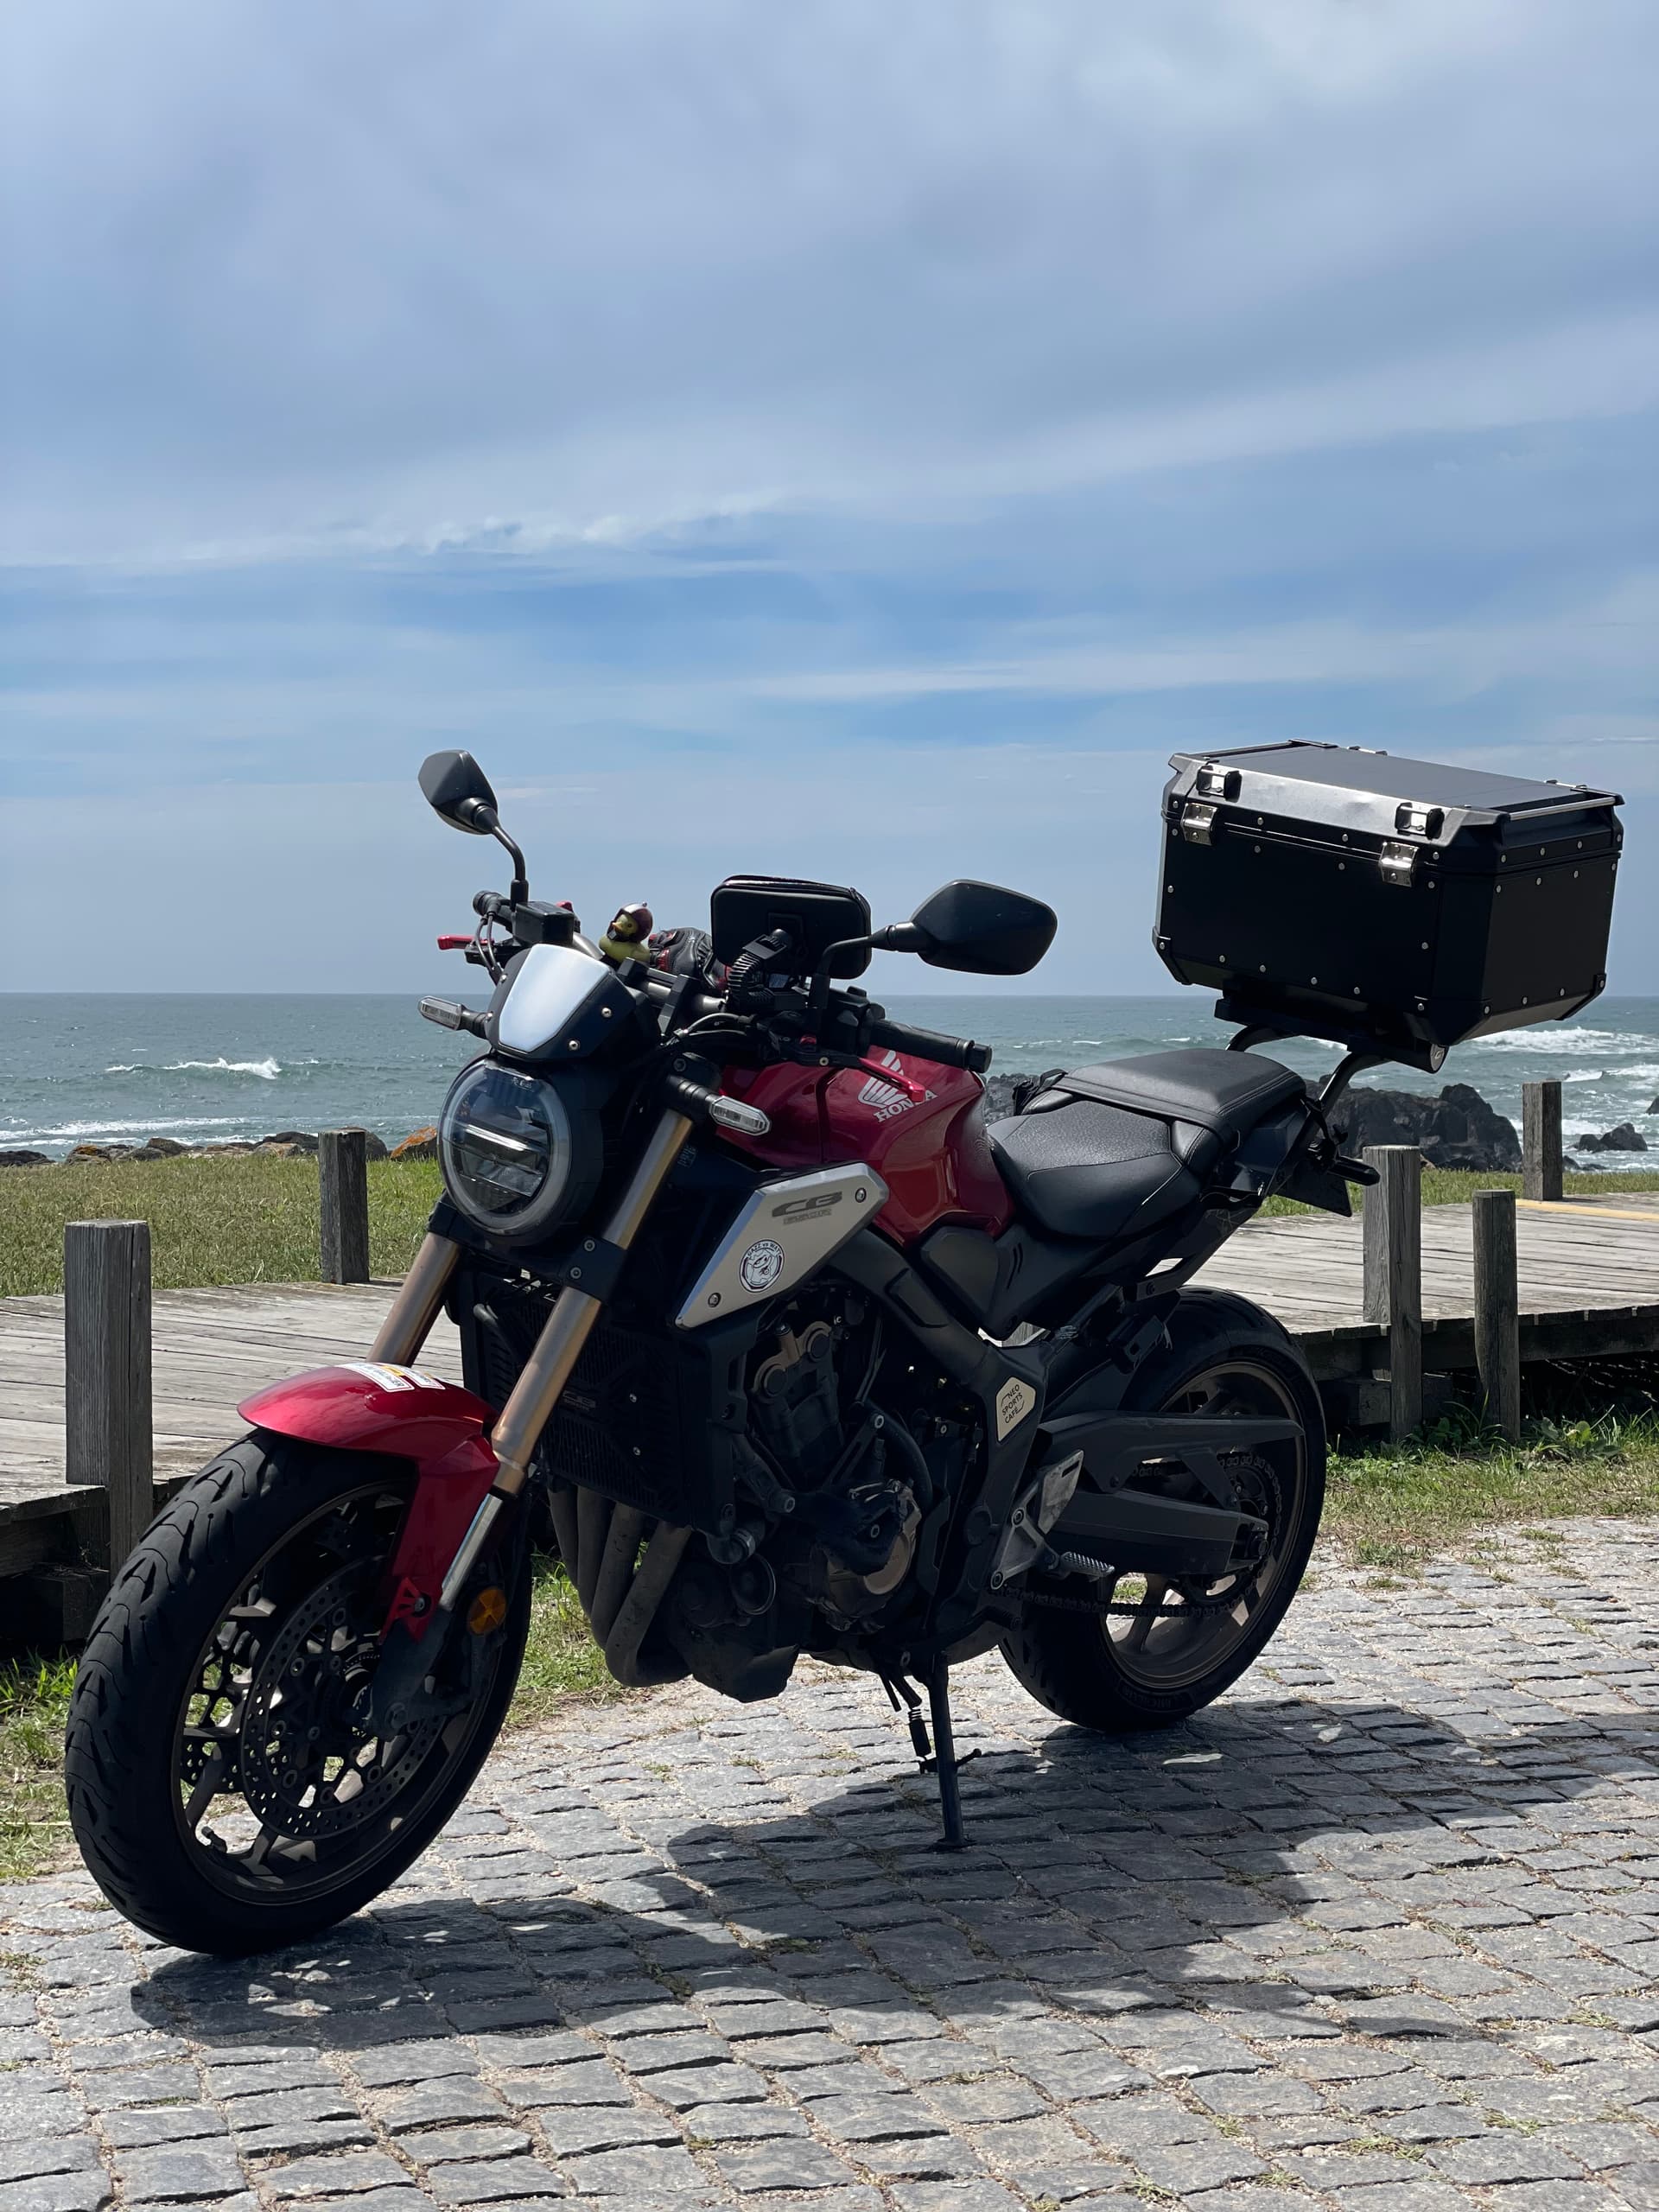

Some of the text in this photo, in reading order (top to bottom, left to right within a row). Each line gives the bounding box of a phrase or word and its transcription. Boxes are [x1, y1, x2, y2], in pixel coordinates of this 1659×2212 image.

[874, 1090, 938, 1122] HONA
[772, 1191, 842, 1217] CB
[1002, 1392, 1023, 1416] SPORTS
[1007, 1384, 1020, 1399] NEO
